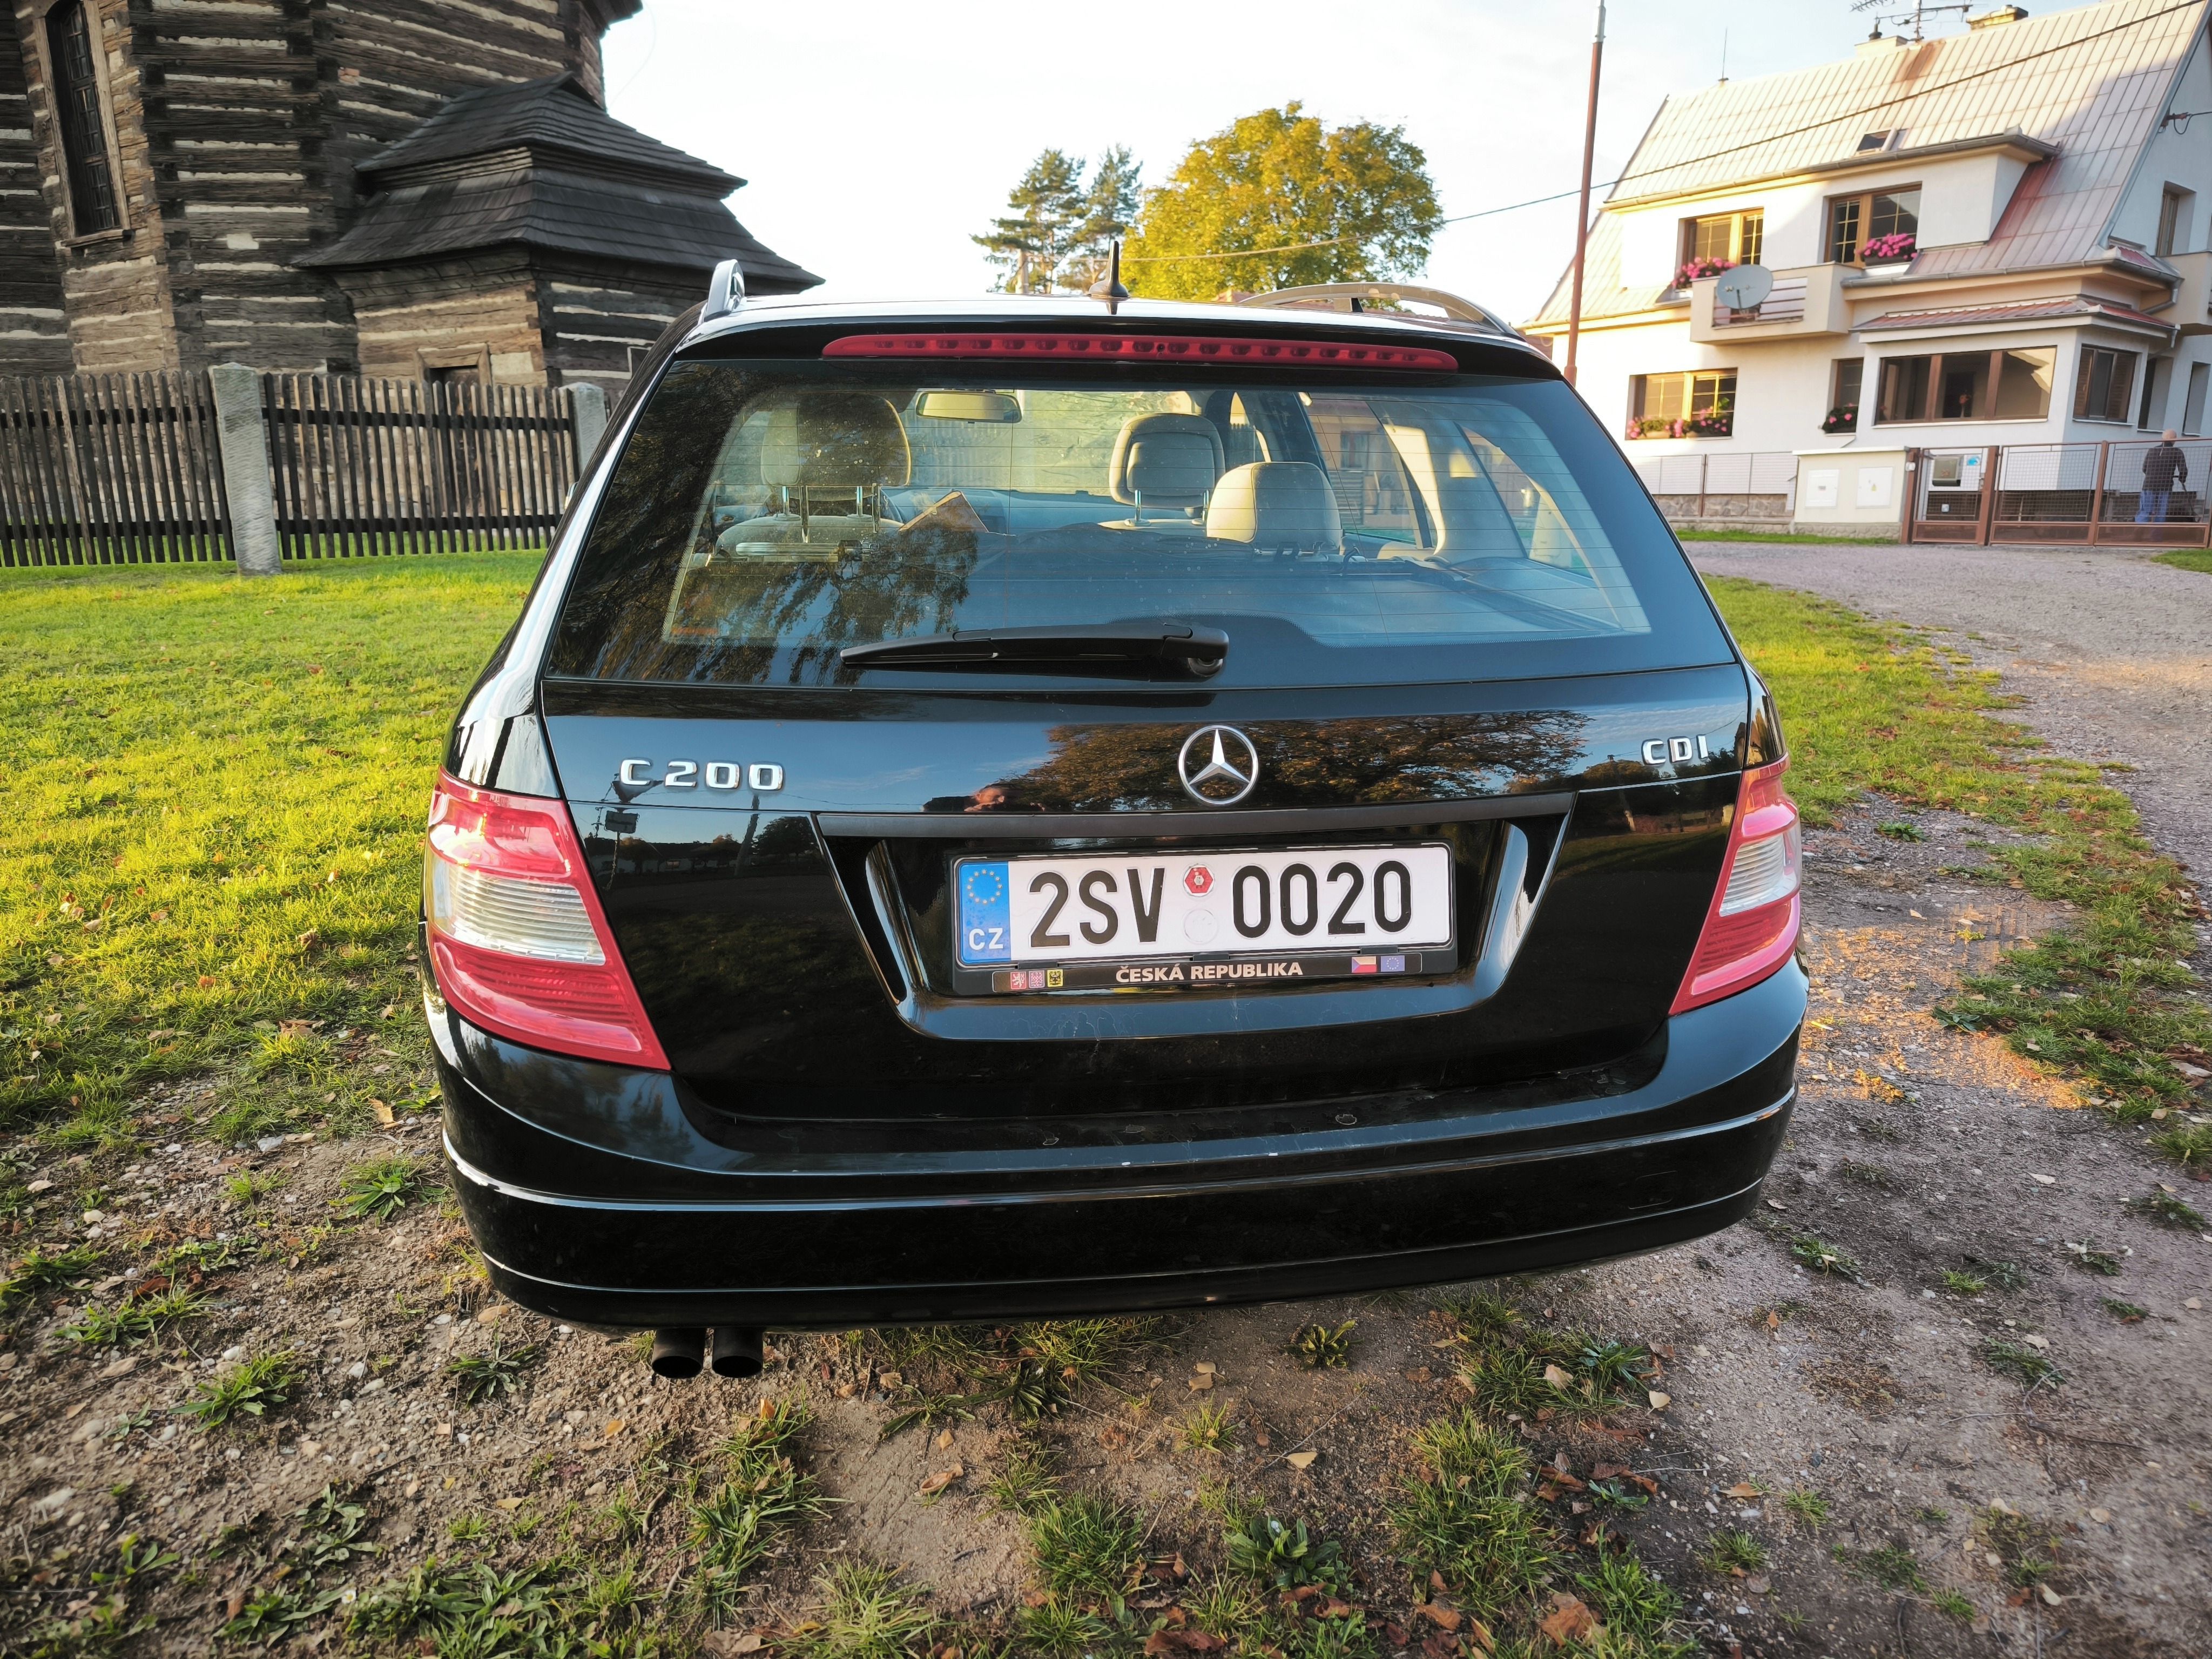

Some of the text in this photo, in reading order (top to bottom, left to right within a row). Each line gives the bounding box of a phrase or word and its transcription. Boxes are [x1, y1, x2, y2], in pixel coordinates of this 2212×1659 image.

[1641, 734, 1710, 766] CDI
[621, 759, 784, 791] C 200
[1028, 859, 1413, 948] 2SV 0020
[968, 927, 1004, 950] CZ
[1115, 961, 1304, 983] ČESKÁ REPUBLIKA
